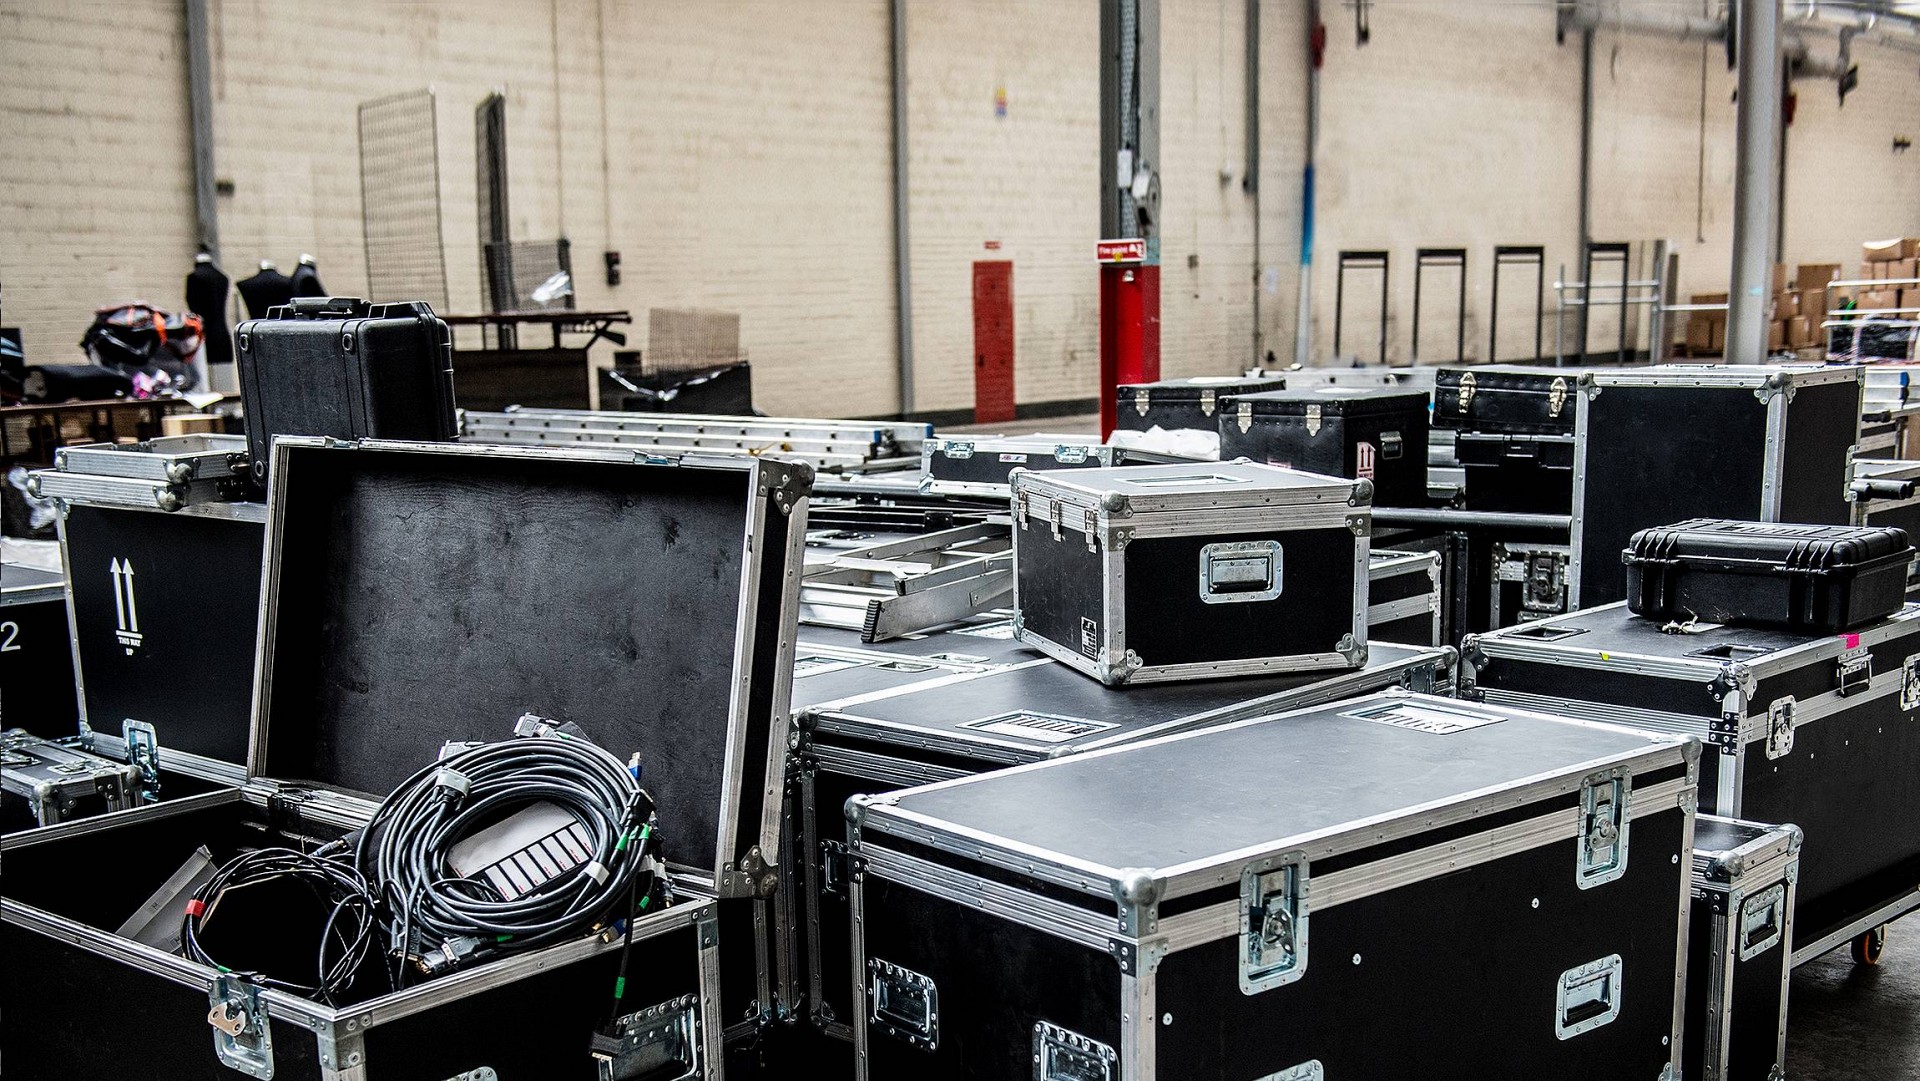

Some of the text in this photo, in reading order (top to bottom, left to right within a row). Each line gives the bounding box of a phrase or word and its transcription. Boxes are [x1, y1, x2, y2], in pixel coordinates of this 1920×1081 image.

[0, 621, 21, 652] 2
[118, 637, 141, 647] THIS WAY
[125, 648, 134, 656] UP
